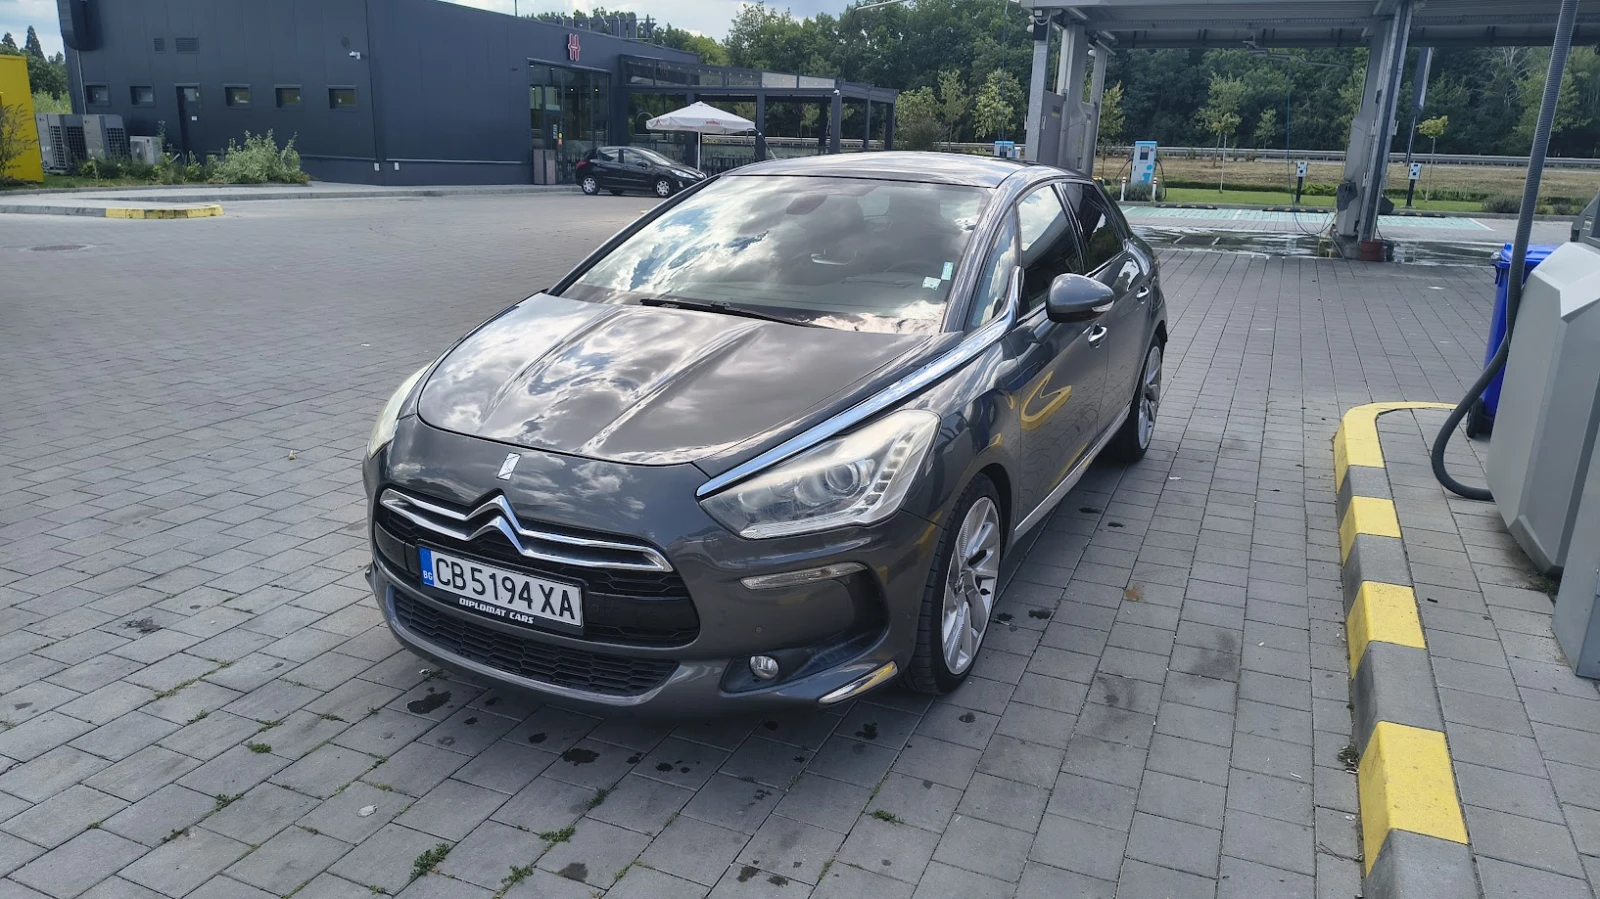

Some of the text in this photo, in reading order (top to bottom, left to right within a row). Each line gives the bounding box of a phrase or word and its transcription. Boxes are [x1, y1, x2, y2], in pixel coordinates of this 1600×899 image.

[423, 570, 433, 581] BG
[459, 597, 534, 624] DIPLOMAT CARS
